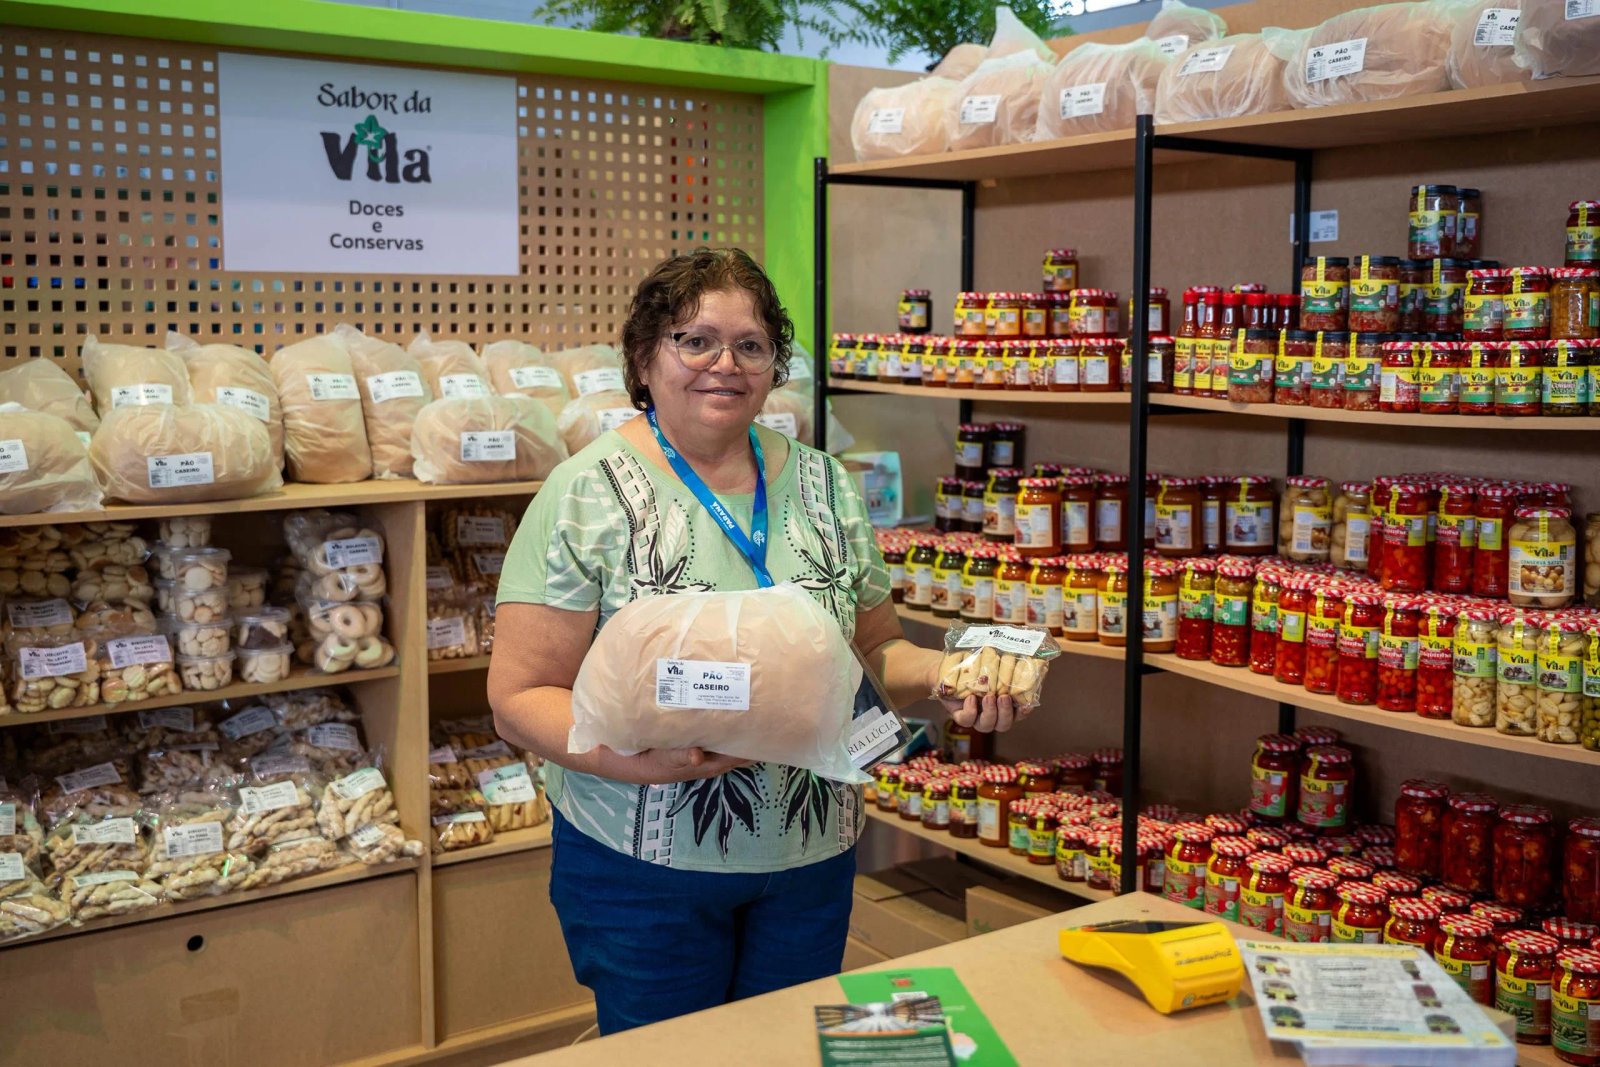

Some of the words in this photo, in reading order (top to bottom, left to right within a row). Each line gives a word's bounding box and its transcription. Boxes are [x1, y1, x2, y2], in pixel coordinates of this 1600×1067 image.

[404, 91, 431, 113] da
[320, 129, 432, 184] Vila
[349, 200, 405, 218] Doces
[372, 221, 383, 233] e
[329, 233, 424, 251] Conservas
[1511, 655, 1529, 664] Vila
[1546, 661, 1564, 671] Vila
[703, 670, 723, 680] PÃO
[693, 682, 730, 692] CASEIRO
[866, 719, 898, 743] LÚCIA
[1506, 980, 1522, 991] Vila
